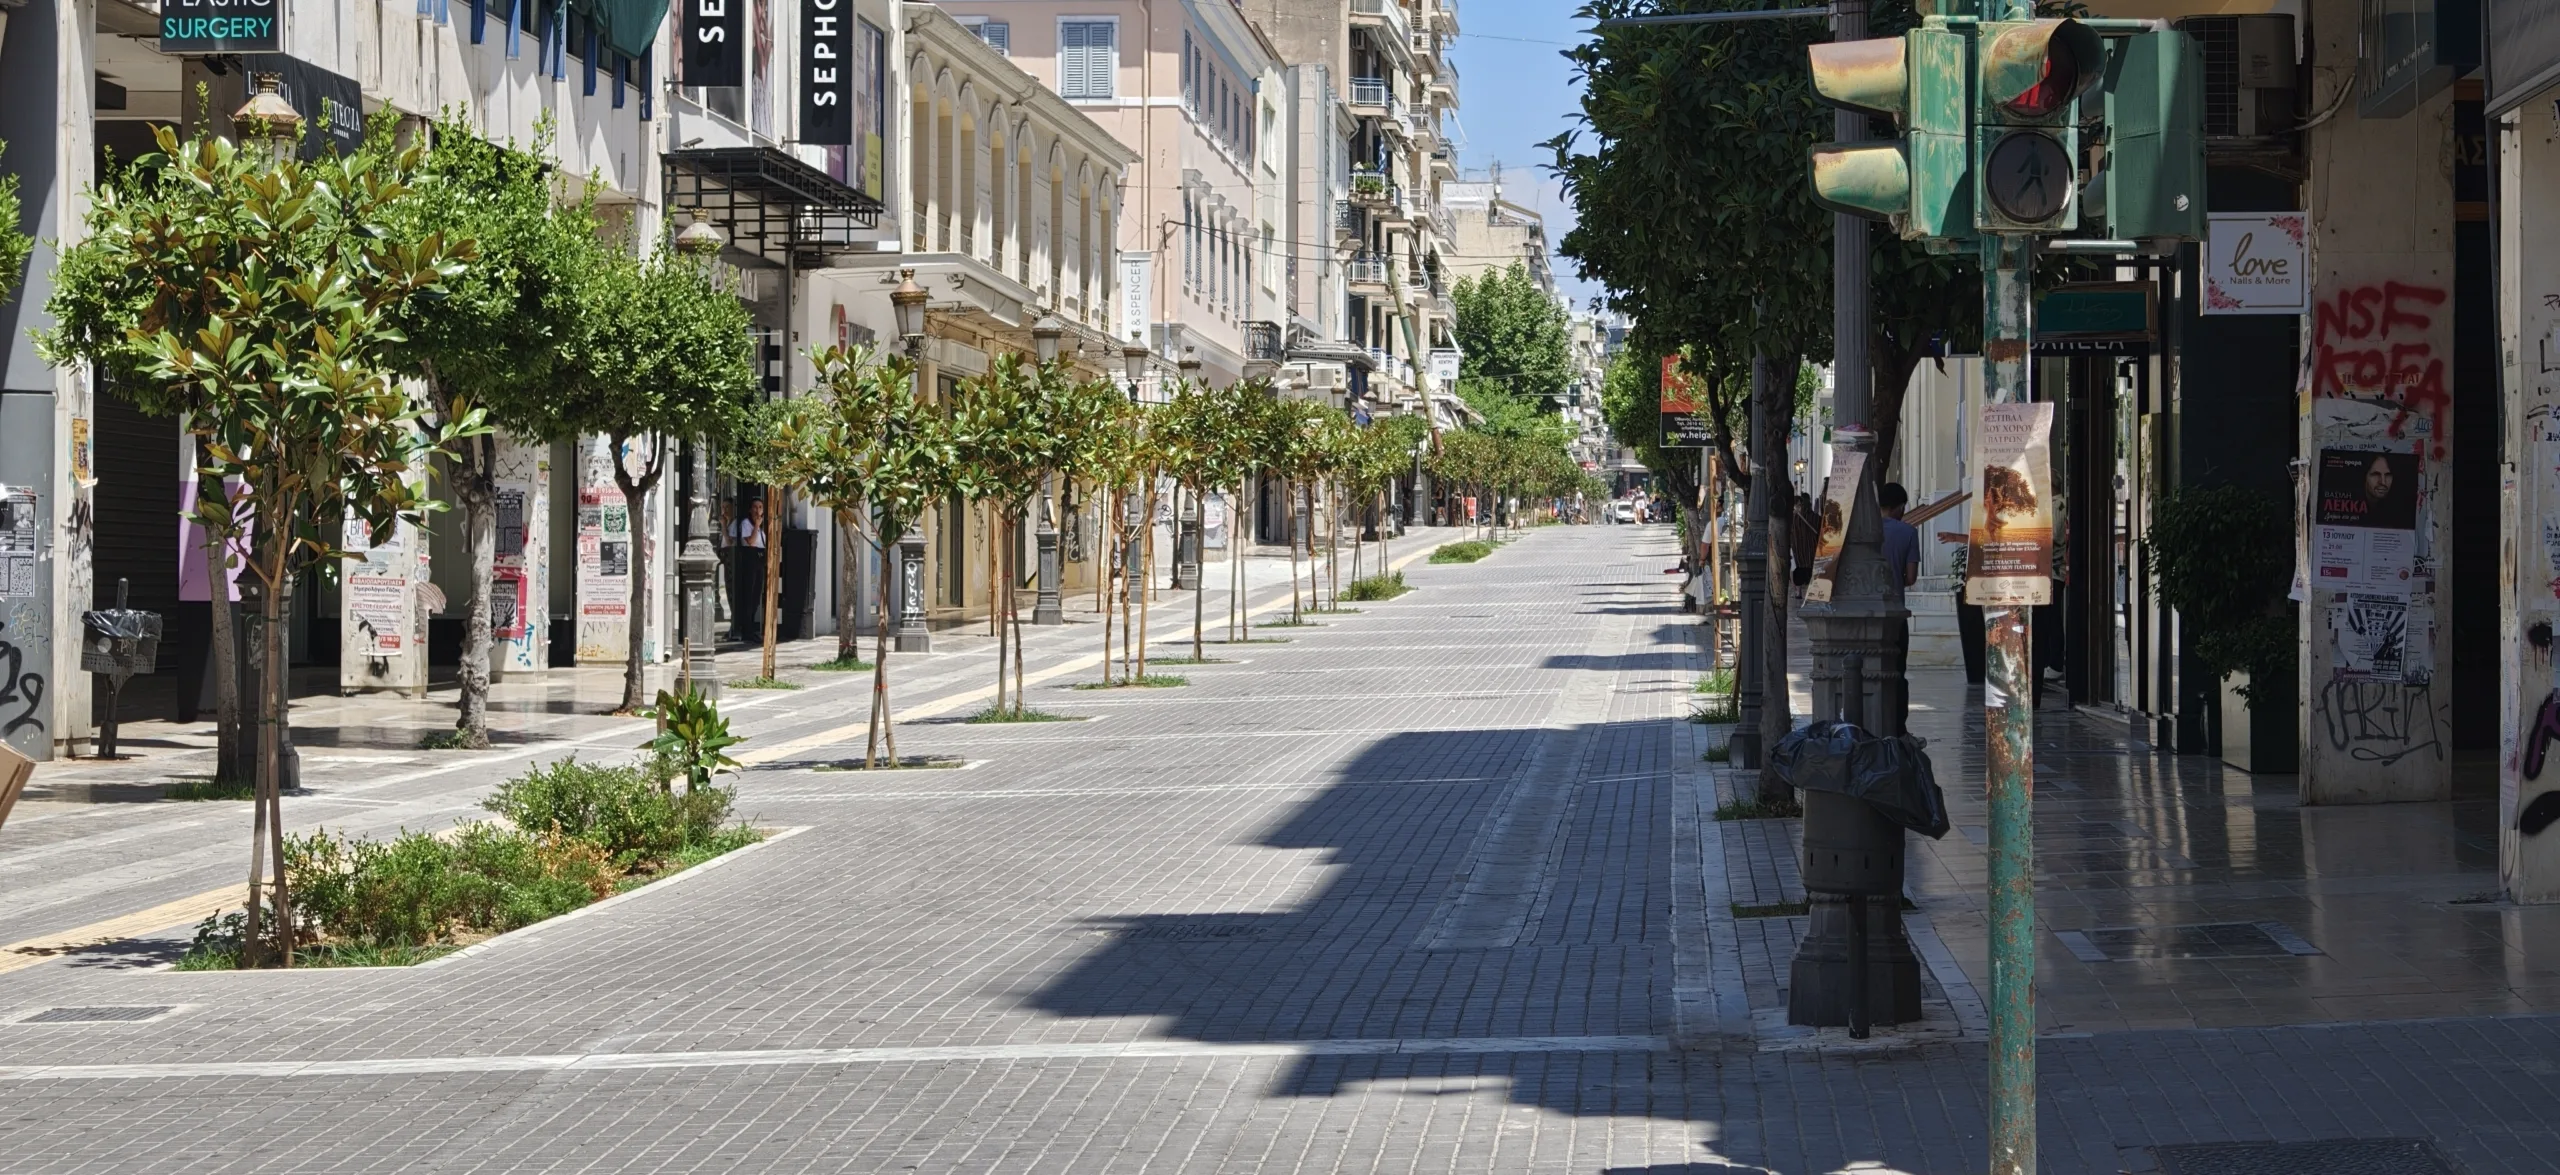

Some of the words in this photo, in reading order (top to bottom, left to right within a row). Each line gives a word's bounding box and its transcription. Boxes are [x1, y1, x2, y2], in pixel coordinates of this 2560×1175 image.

[165, 18, 272, 38] SURGERY
[2229, 232, 2288, 276] love
[1131, 260, 1141, 316] SPENCER
[2230, 277, 2252, 285] Nails
[2255, 277, 2266, 285] &
[2266, 277, 2290, 285] More
[2324, 499, 2368, 514] ΛΕΚΚΑ
